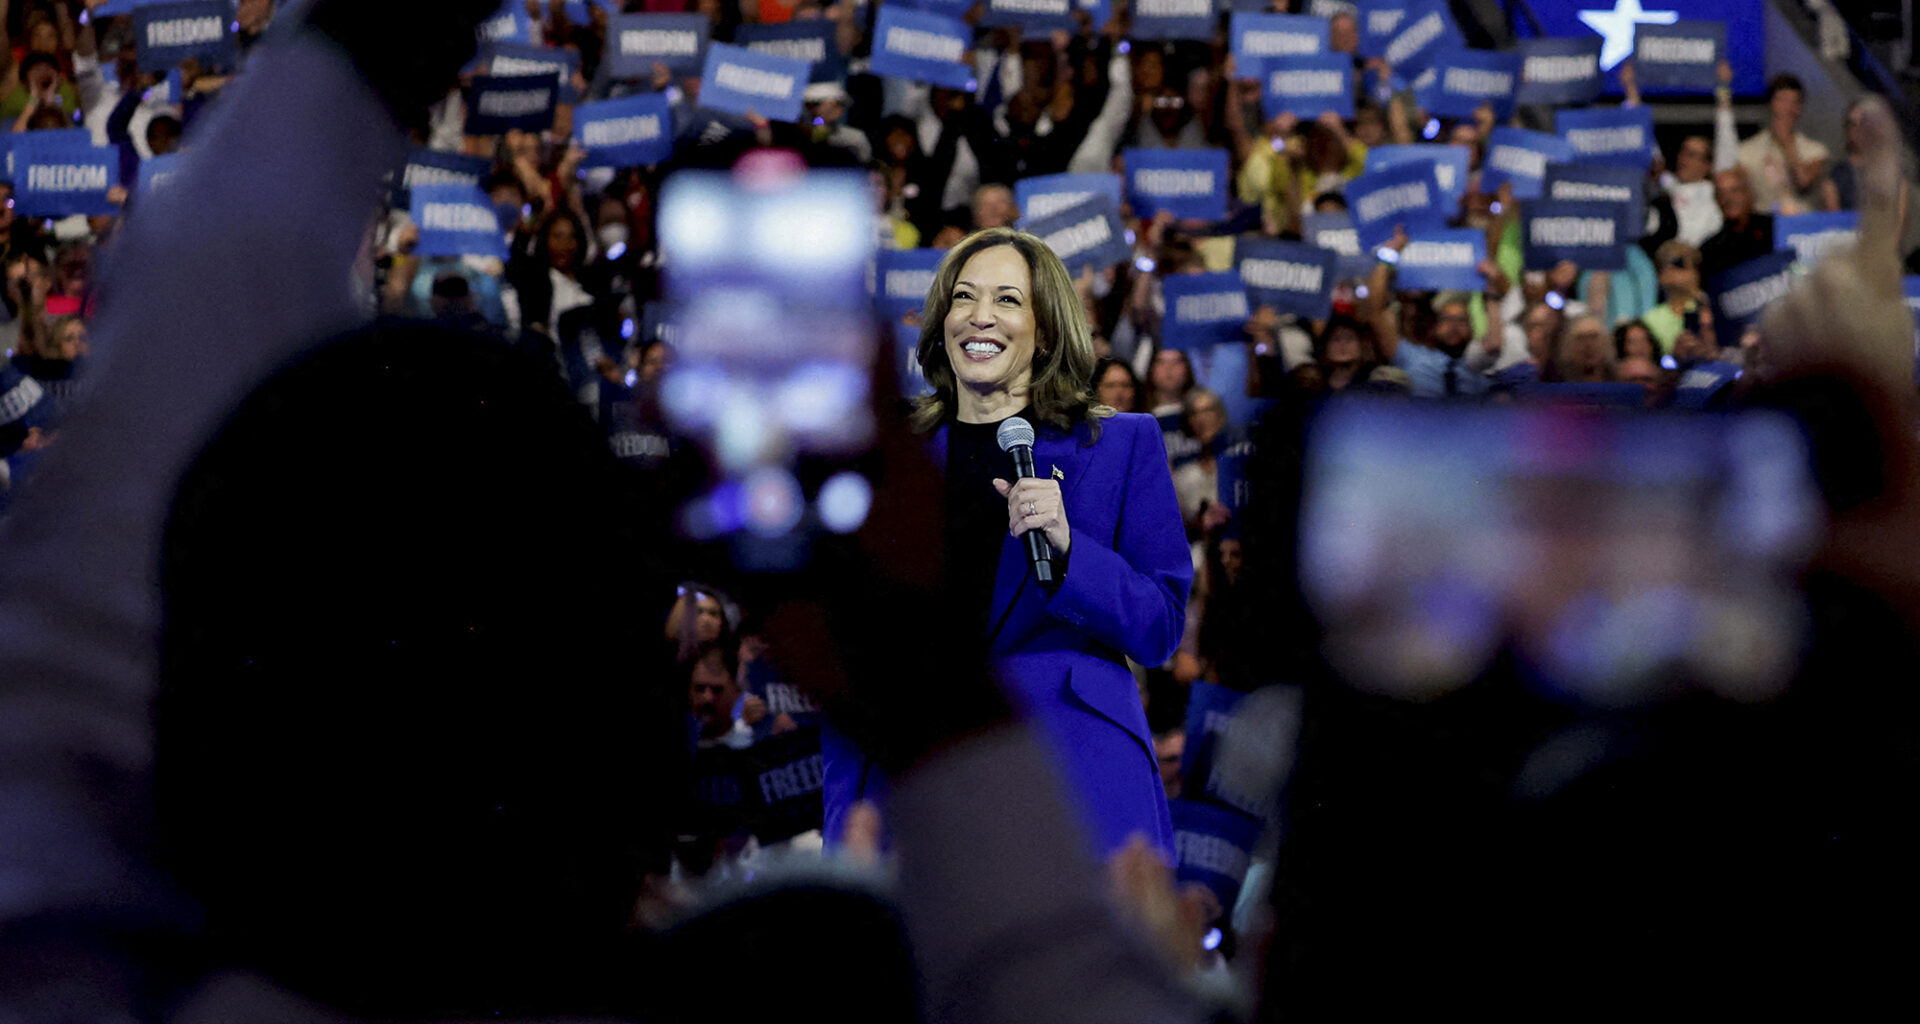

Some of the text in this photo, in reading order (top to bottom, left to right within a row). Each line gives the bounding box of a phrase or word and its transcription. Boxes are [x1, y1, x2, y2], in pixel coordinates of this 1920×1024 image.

[147, 15, 224, 48] FREEDOM
[620, 29, 699, 57] FREEDOM
[885, 26, 964, 64] FREEDOM
[1242, 31, 1321, 58] FREEDOM
[1637, 36, 1716, 65] FREEDOM
[714, 62, 795, 101] FREEDOM
[1269, 70, 1345, 98] FREEDOM
[1442, 65, 1514, 98] FREEDOM
[1522, 54, 1598, 84] FREEDOM
[583, 113, 662, 147] FREEDOM
[1565, 125, 1644, 155] FREEDOM
[27, 164, 108, 193] FREEDOM
[1135, 168, 1216, 198] FREEDOM
[422, 202, 499, 233] FREEDOM
[1358, 181, 1430, 225] FREEDOM
[1529, 216, 1616, 248] FREEDOM
[1240, 258, 1324, 295] FREEDOM
